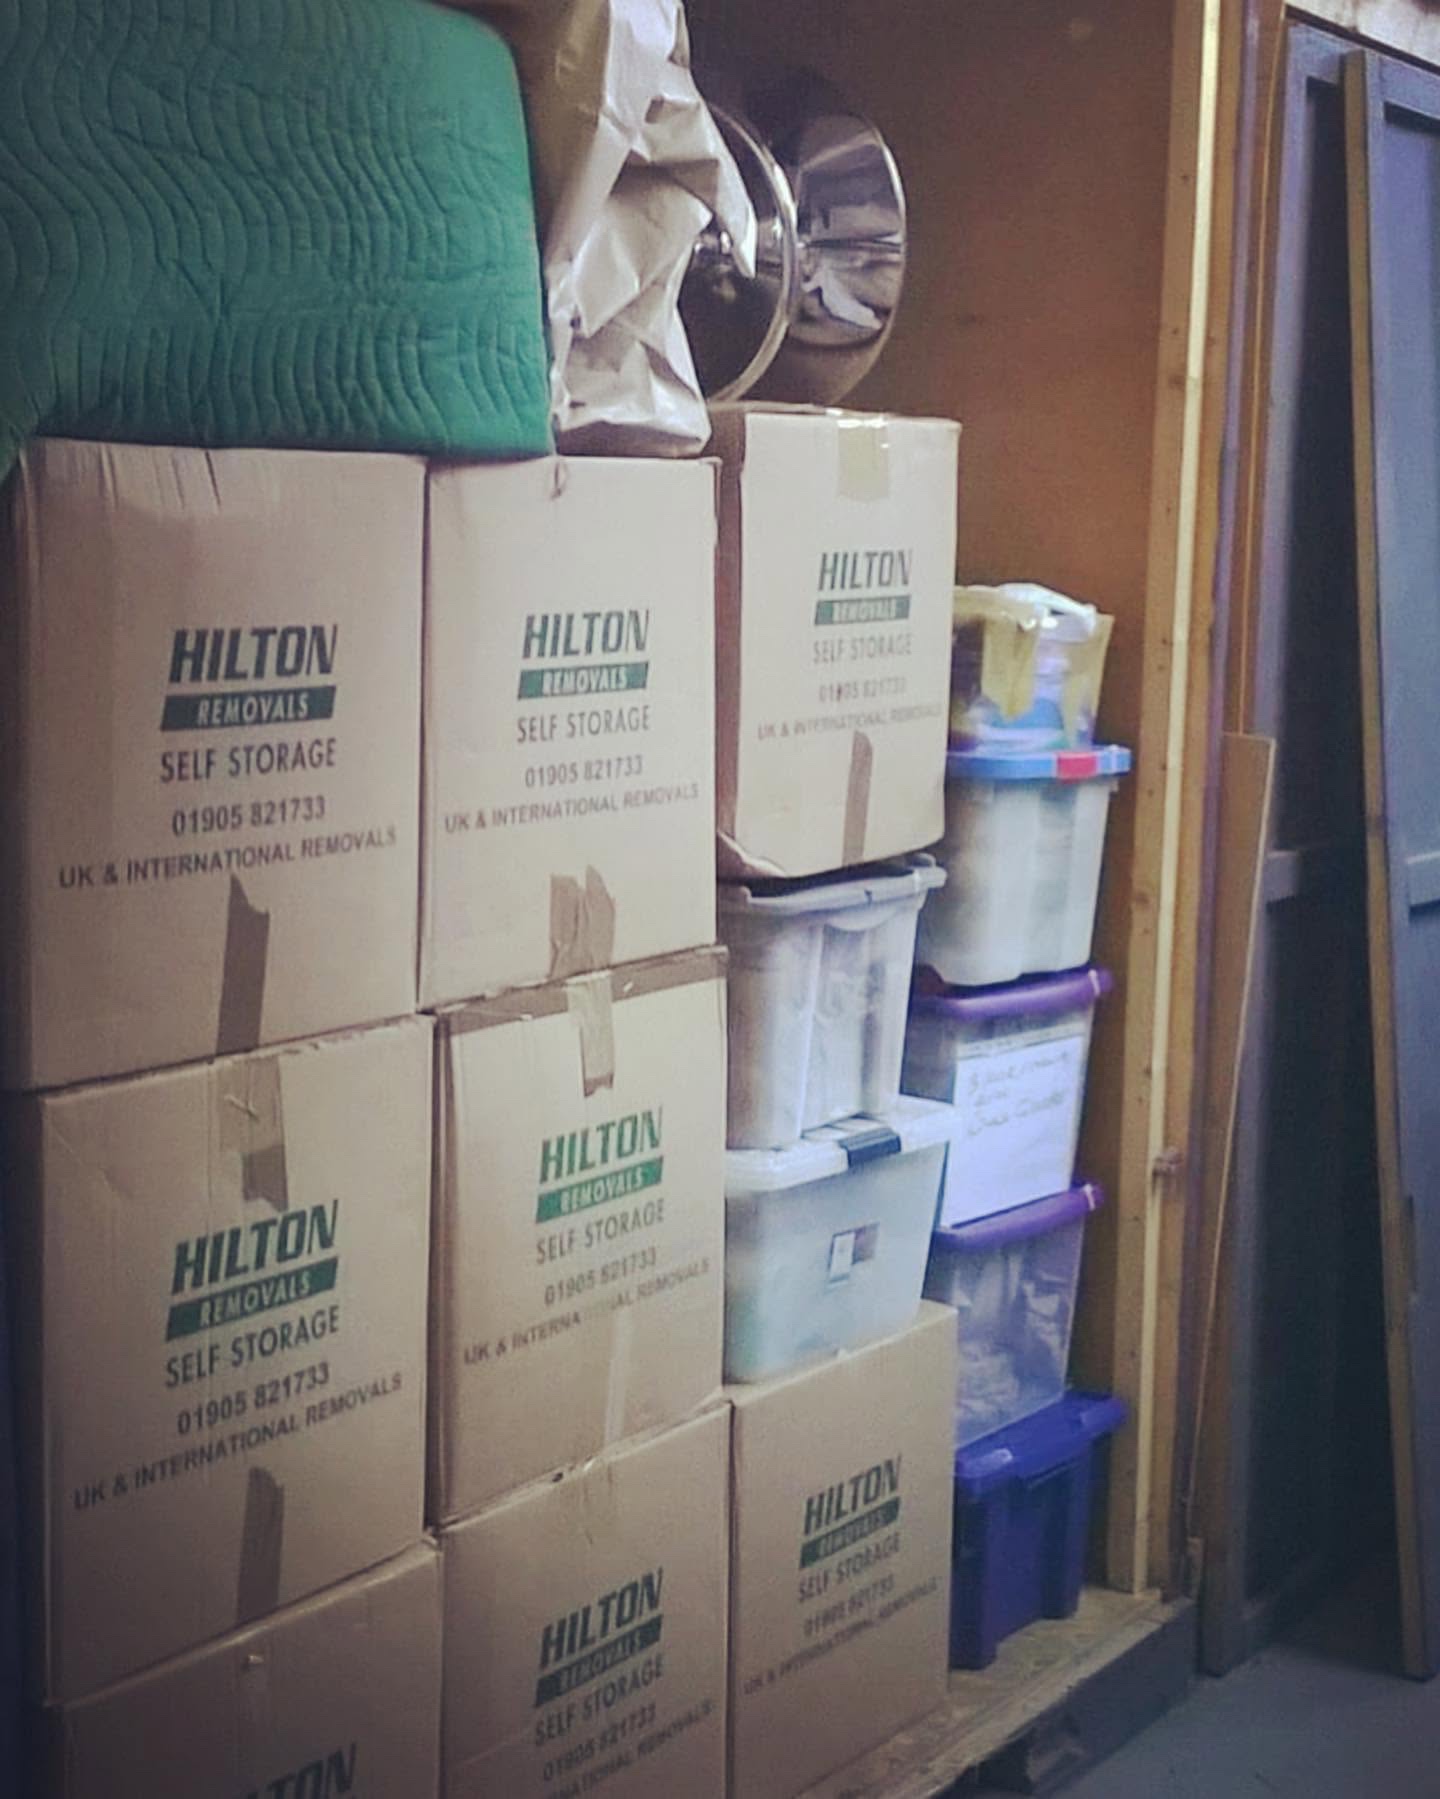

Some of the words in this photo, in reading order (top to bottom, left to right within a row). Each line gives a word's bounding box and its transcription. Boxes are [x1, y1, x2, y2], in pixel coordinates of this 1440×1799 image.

[818, 549, 912, 591] HILTON
[168, 624, 338, 683] HILTON
[522, 608, 649, 659] HILTON
[196, 692, 309, 726] REMOVALS
[542, 665, 629, 696] REMOVALS
[517, 714, 558, 744] SELF
[567, 705, 650, 739] STORAGE
[160, 748, 217, 783] SELF
[228, 738, 337, 777] STORAGE
[525, 762, 578, 788] 01905
[584, 754, 643, 781] 821733
[172, 806, 244, 837] 01905
[250, 795, 326, 828] 821733
[444, 812, 470, 834] UK
[475, 811, 487, 831] &
[491, 796, 618, 828] INTERNATIONAL
[622, 783, 699, 810] REMOVALS
[59, 864, 95, 888] UK
[103, 862, 118, 885] &
[127, 844, 295, 882] INTERNATIONAL
[301, 825, 397, 858] REMOVALS
[540, 1105, 663, 1184] HILTON
[171, 1199, 338, 1295] HILTON
[536, 1228, 576, 1265] SELF
[585, 1198, 665, 1249] STORAGE
[201, 1270, 312, 1328] REMOVALS
[545, 1270, 596, 1306] 01905
[166, 1345, 225, 1388] SELF
[232, 1305, 340, 1368] STORAGE
[464, 1341, 489, 1365] UK
[177, 1391, 247, 1436] 01905
[254, 1362, 330, 1410] 821733
[73, 1482, 105, 1511] UK
[113, 1472, 128, 1497] &
[135, 1414, 299, 1490] INTERNATIONAL
[305, 1372, 402, 1427] REMOVALS
[804, 1453, 902, 1536] HILTON
[539, 1566, 662, 1670] HILTON
[535, 1702, 577, 1747] SELF
[583, 1652, 665, 1721] STORAGE
